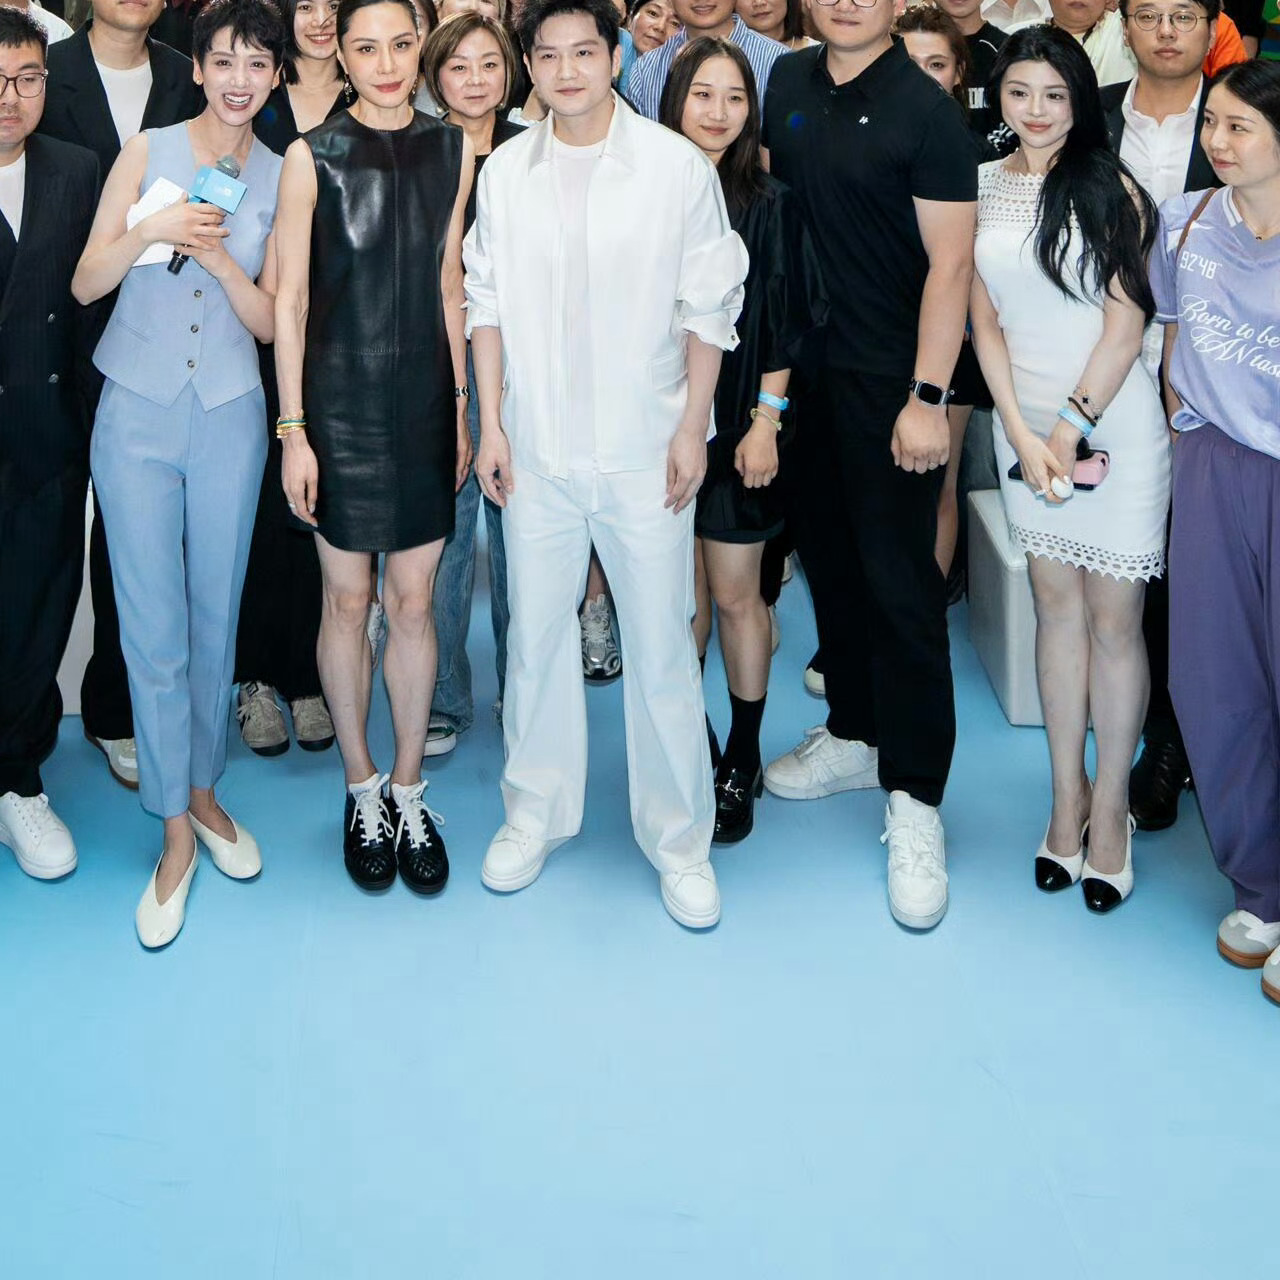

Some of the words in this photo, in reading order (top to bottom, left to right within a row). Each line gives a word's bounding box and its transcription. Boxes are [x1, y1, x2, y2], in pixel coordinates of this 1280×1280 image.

[1178, 294, 1232, 332] Born
[1235, 321, 1254, 341] to
[1256, 324, 1280, 349] be
